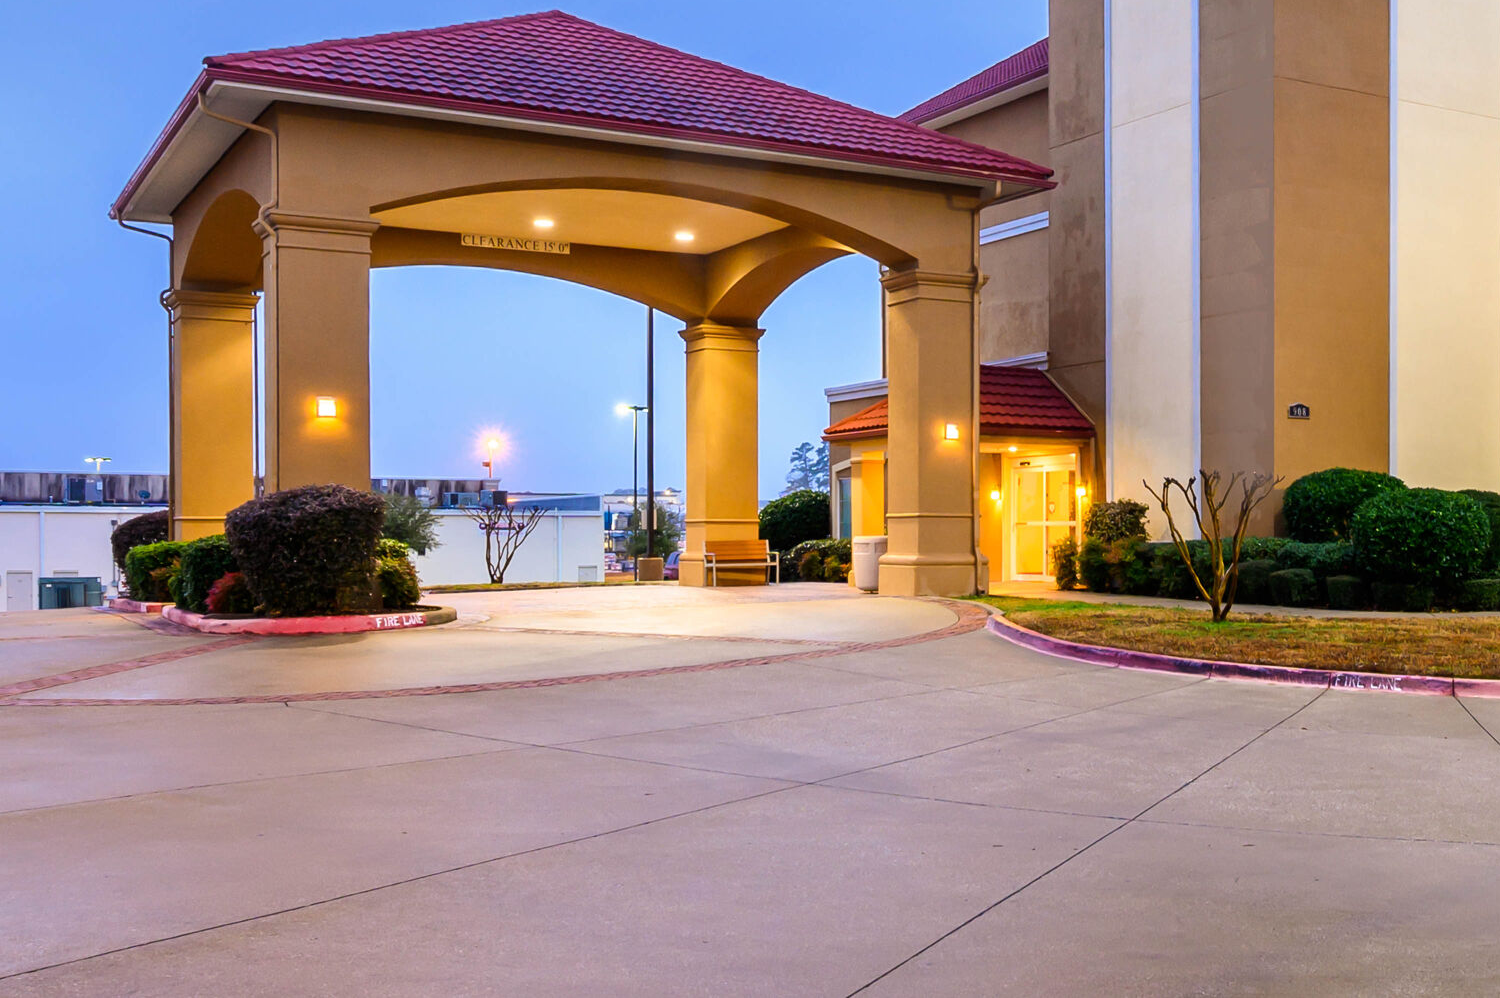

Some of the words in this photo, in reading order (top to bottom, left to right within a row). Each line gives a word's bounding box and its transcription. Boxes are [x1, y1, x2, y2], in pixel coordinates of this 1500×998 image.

[462, 234, 540, 251] CLEARANCE
[375, 616, 401, 628] FIRE
[402, 614, 424, 626] LANE
[1334, 673, 1364, 688] FIRE
[1370, 677, 1402, 691] LANE
